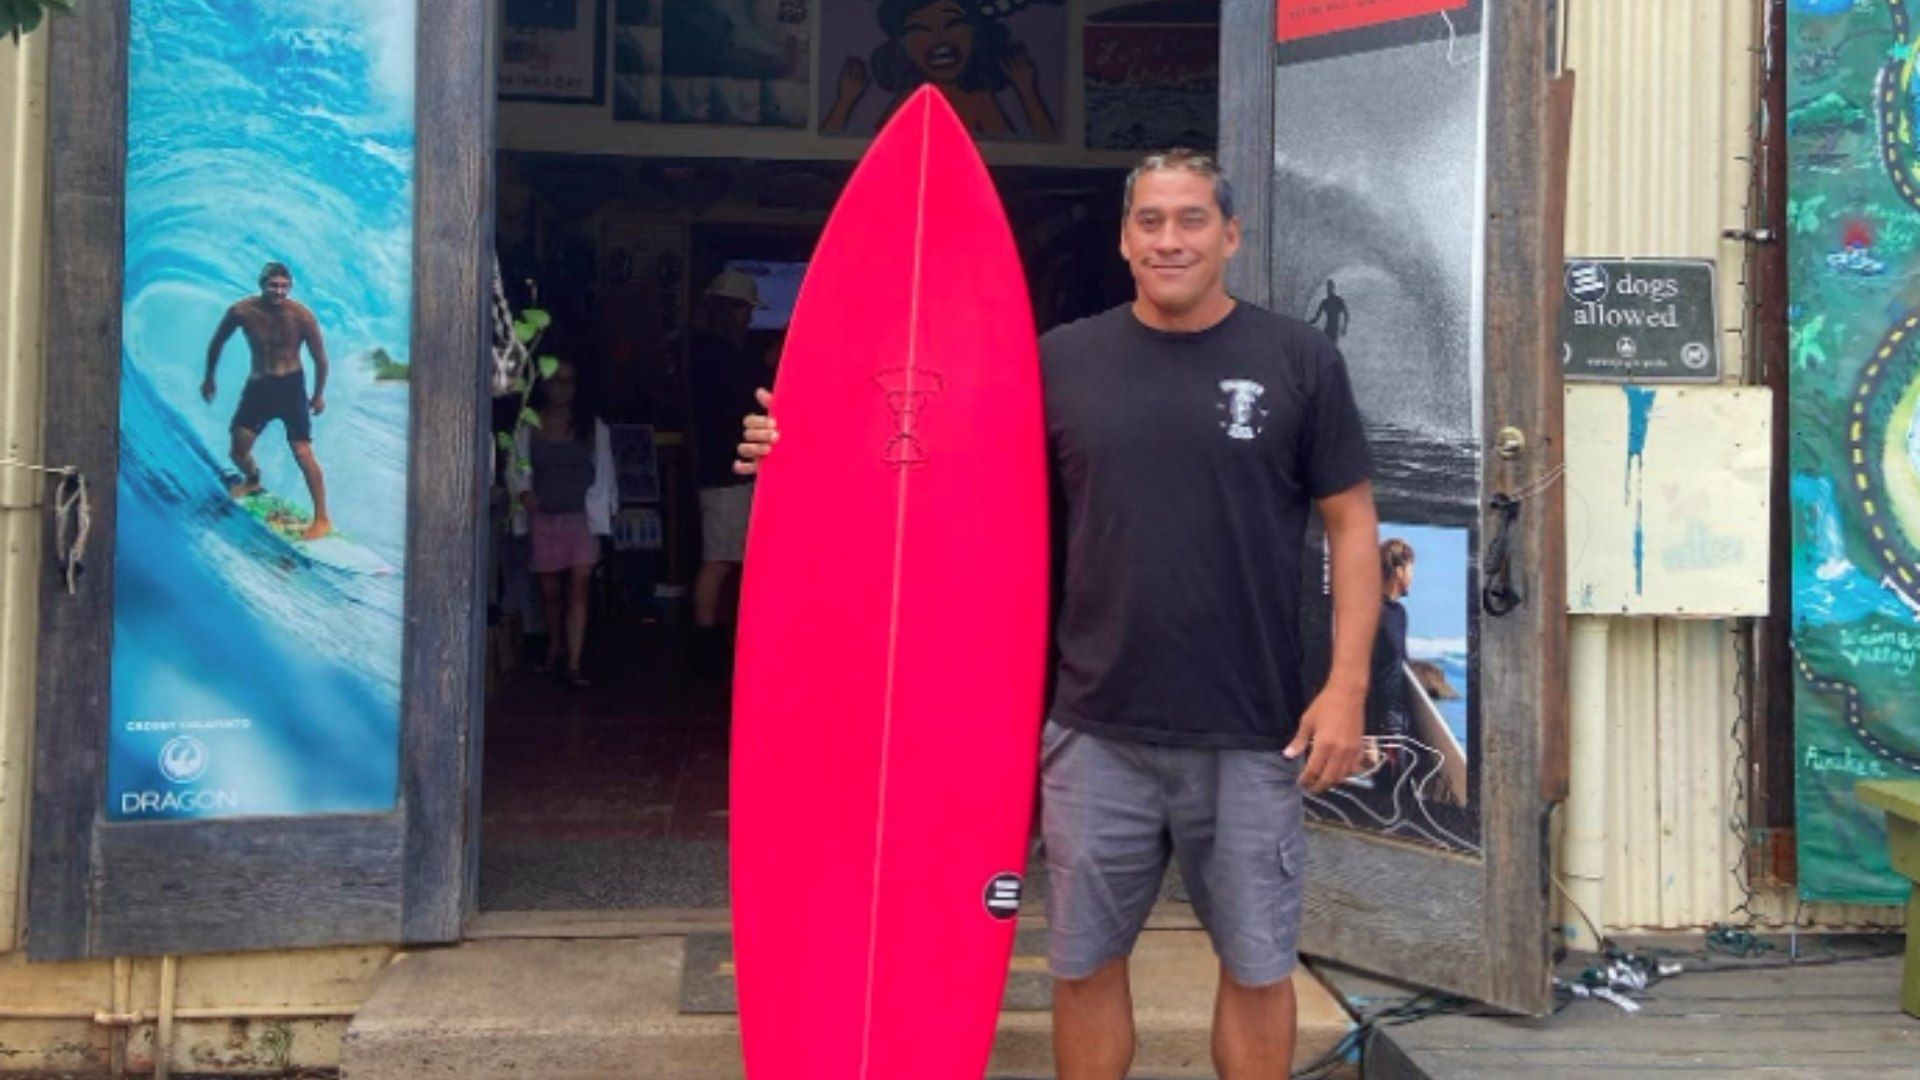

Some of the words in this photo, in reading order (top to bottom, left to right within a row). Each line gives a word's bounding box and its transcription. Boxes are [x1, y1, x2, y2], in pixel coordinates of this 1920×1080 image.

[1616, 272, 1679, 302] dogs
[1574, 301, 1680, 328] allowed
[121, 788, 239, 815] DRAGON
